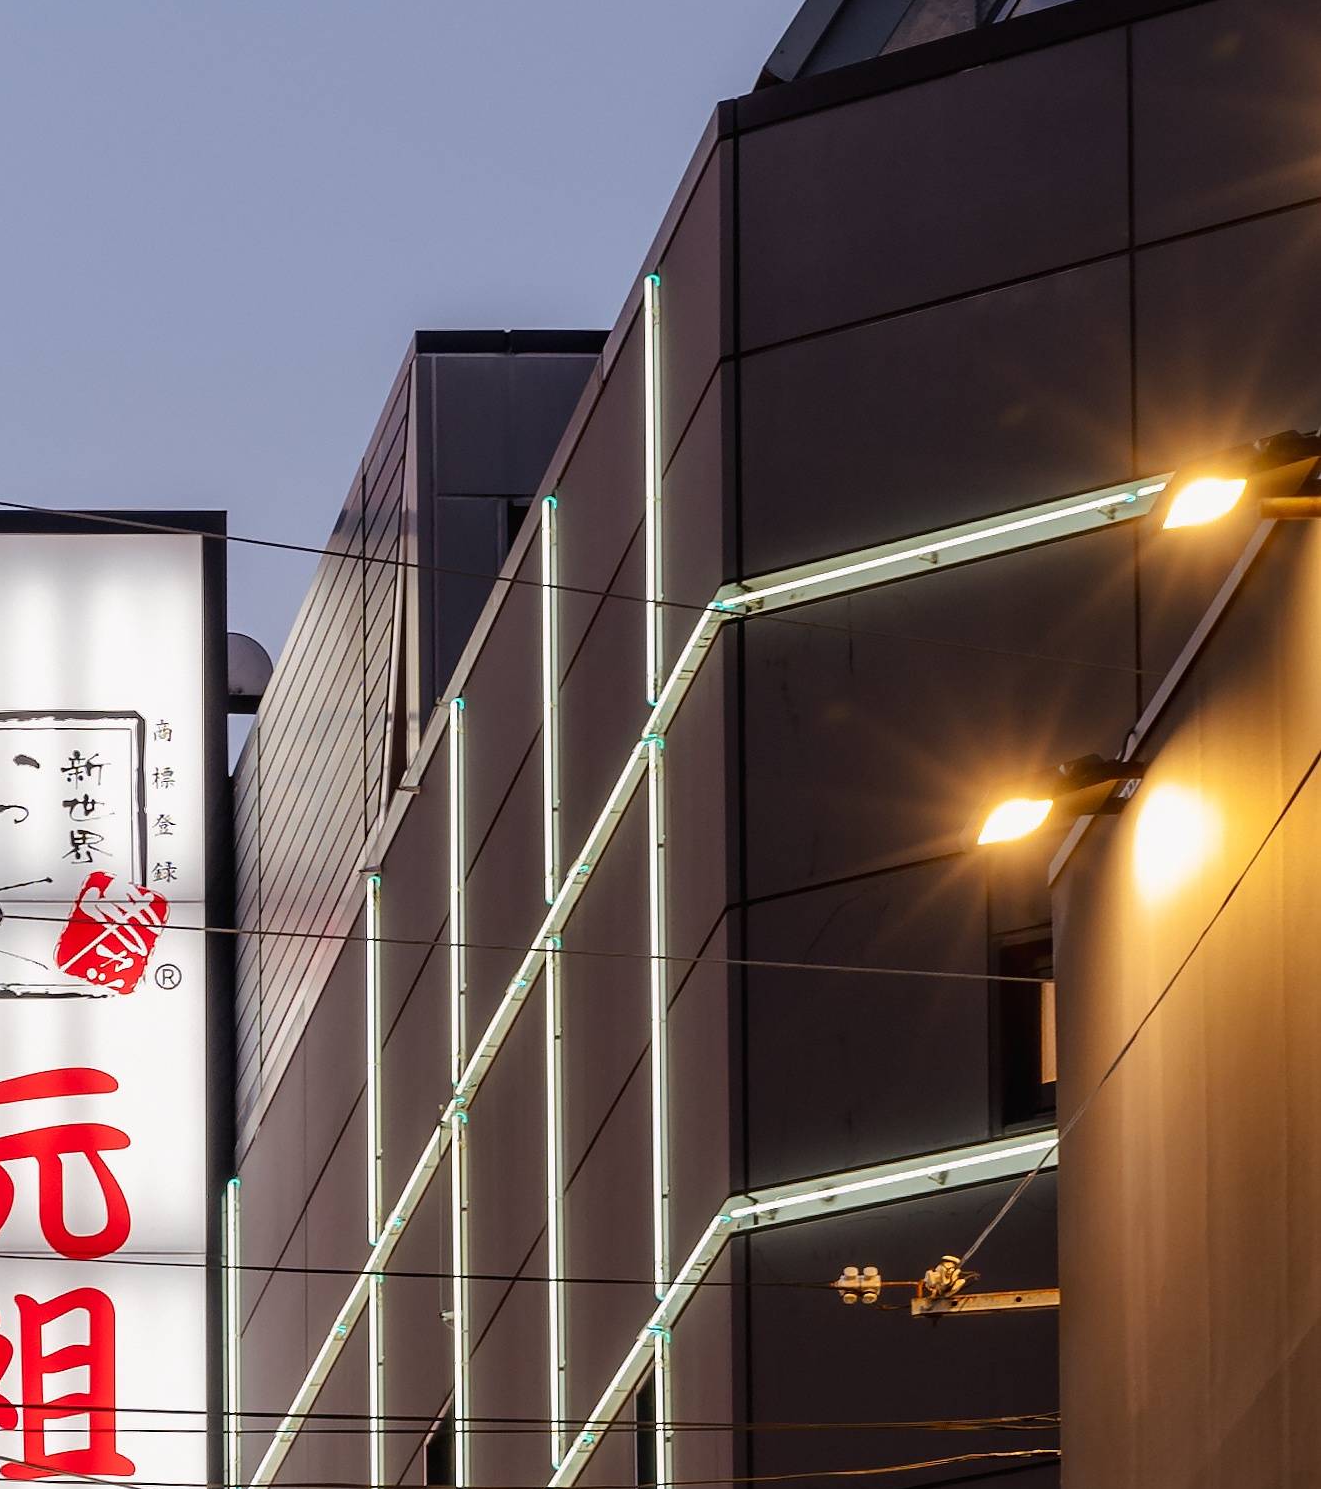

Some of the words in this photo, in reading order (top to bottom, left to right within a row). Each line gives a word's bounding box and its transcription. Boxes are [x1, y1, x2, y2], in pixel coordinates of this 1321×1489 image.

[61, 750, 114, 864] 新世界
[152, 720, 178, 883] 商標登録
